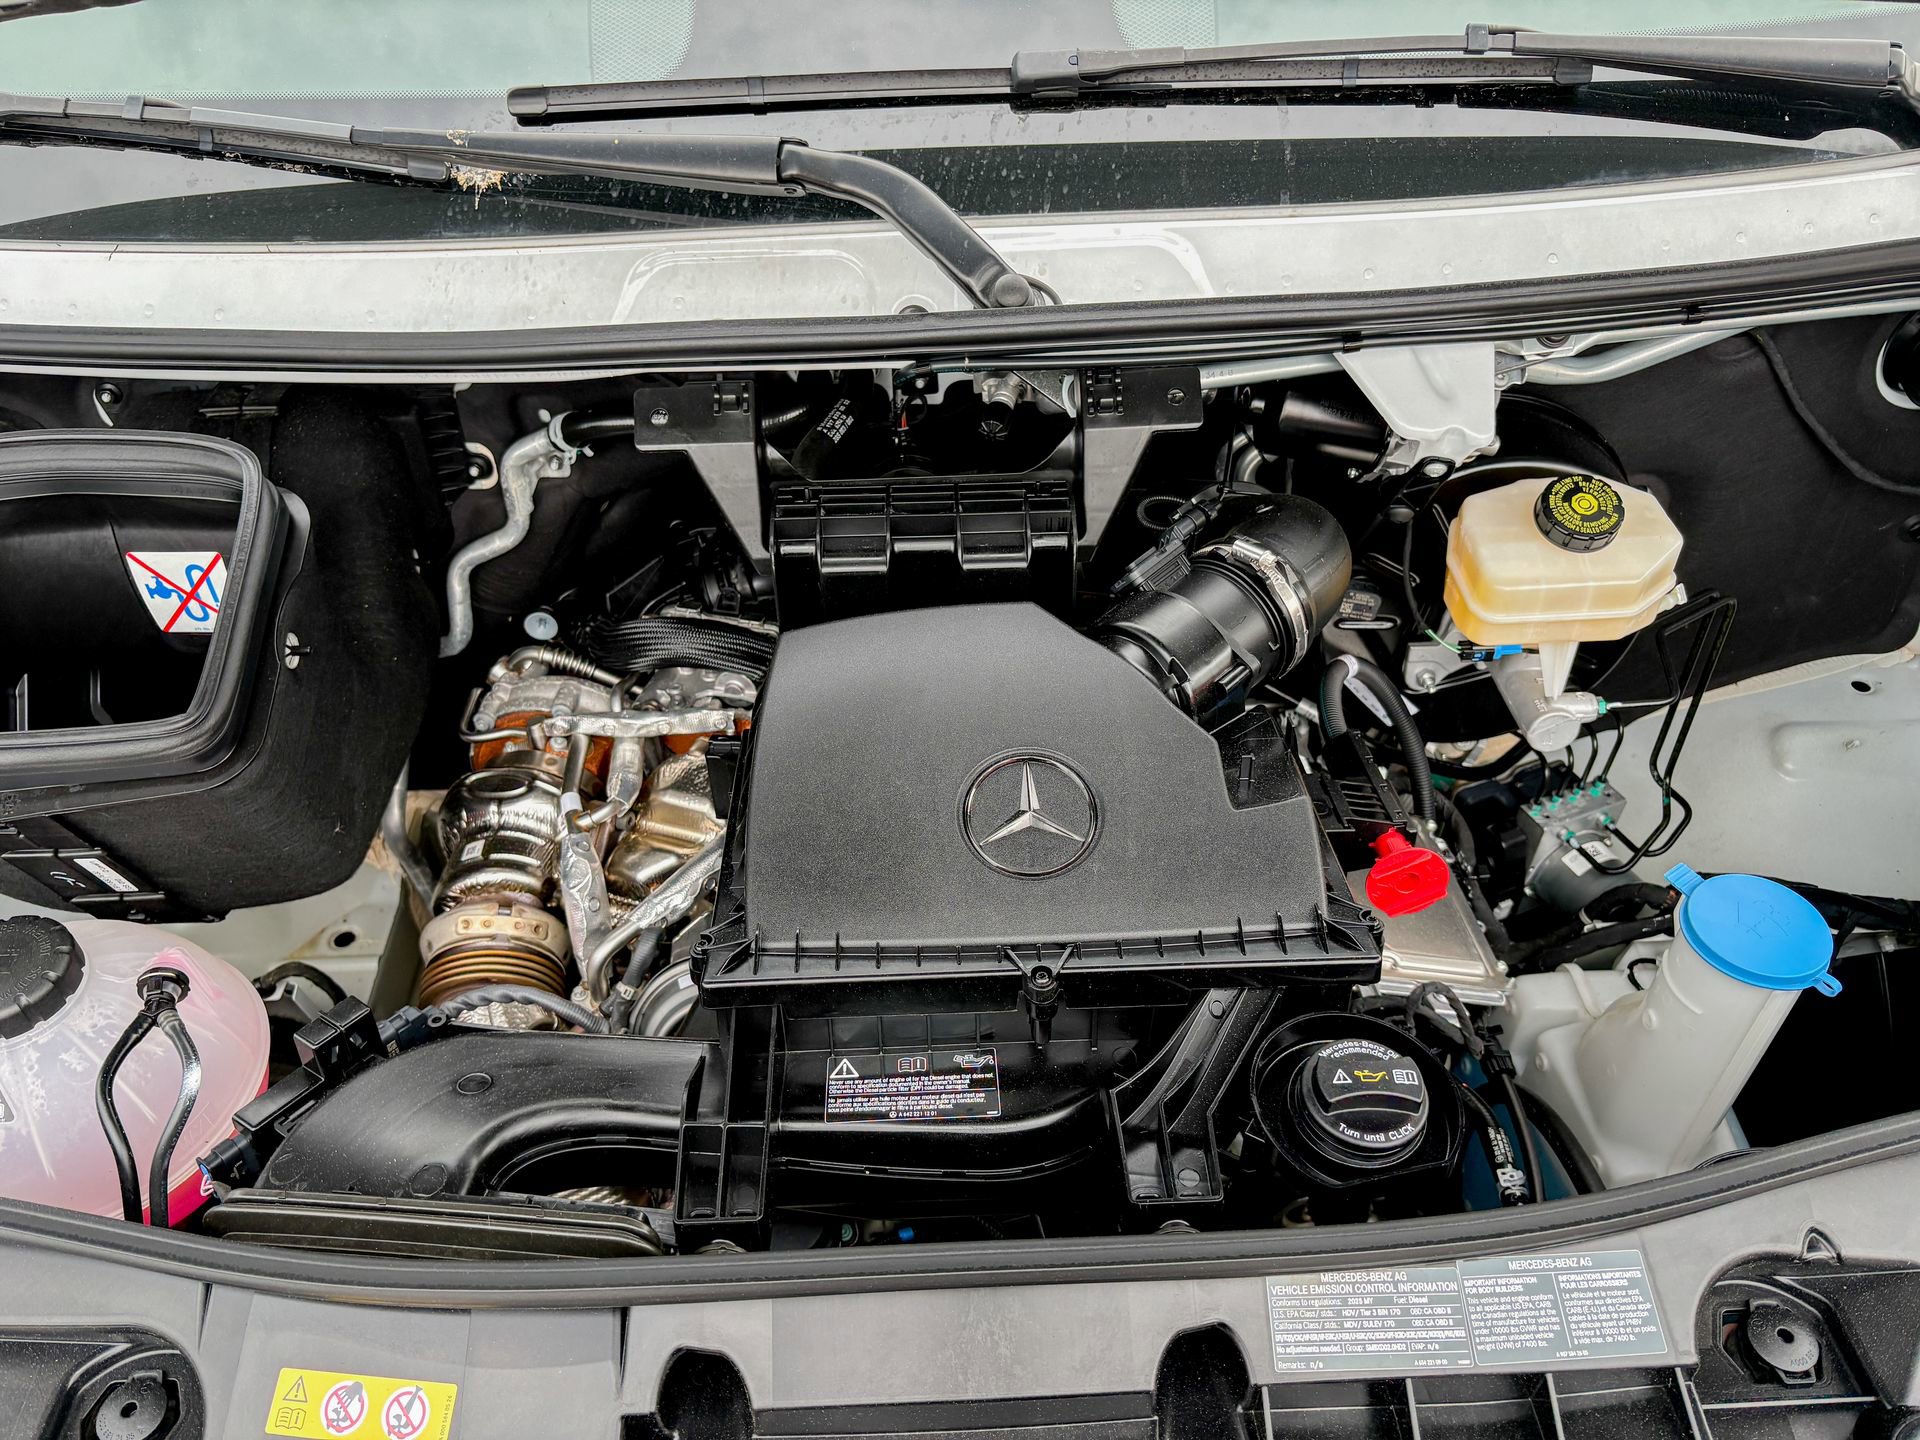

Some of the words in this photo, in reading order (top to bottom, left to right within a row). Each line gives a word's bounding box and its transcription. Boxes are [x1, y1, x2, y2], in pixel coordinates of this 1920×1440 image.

[1318, 1041, 1386, 1058] Mercedes-Benz
[1387, 1049, 1399, 1059] Oil
[1330, 1047, 1390, 1061] recommended
[1339, 1123, 1360, 1139] Turn
[1363, 1133, 1386, 1142] until
[1388, 1123, 1416, 1141] CLICK
[1507, 1256, 1579, 1270] MERCEDES-BENZ
[1578, 1256, 1592, 1266] AG
[1320, 1270, 1392, 1283] MERCEDES-BENZ
[1394, 1271, 1406, 1280] AG
[1463, 1278, 1496, 1286] IMPORTANT
[1496, 1276, 1537, 1285] INFORMATION
[1558, 1272, 1601, 1281] INFORMATIONS
[1601, 1270, 1641, 1279] IMPORTANTES
[1270, 1284, 1308, 1295] VEHICLE
[1310, 1283, 1352, 1294] EMISSION
[1354, 1282, 1396, 1293] CONTROL
[1397, 1280, 1457, 1293] INFORMATION
[1494, 1284, 1523, 1292] BUILDERS
[1588, 1278, 1628, 1287] CARROSSIERS
[1511, 1295, 1530, 1303] engine
[1564, 1298, 1593, 1306] conformes
[1604, 1296, 1631, 1304] directives
[1483, 1303, 1511, 1312] applicable
[1534, 1300, 1551, 1308] CARB
[1508, 1309, 1539, 1318] regulations
[1492, 1317, 1527, 1326] manufacture
[1536, 1315, 1560, 1323] vehicles
[1473, 1327, 1490, 1335] under
[1491, 1326, 1509, 1334] 10000
[1519, 1324, 1537, 1332] GVWR
[1480, 1334, 1507, 1342] maximum
[1476, 1343, 1495, 1351] weight
[1495, 1341, 1515, 1350] (UVW)
